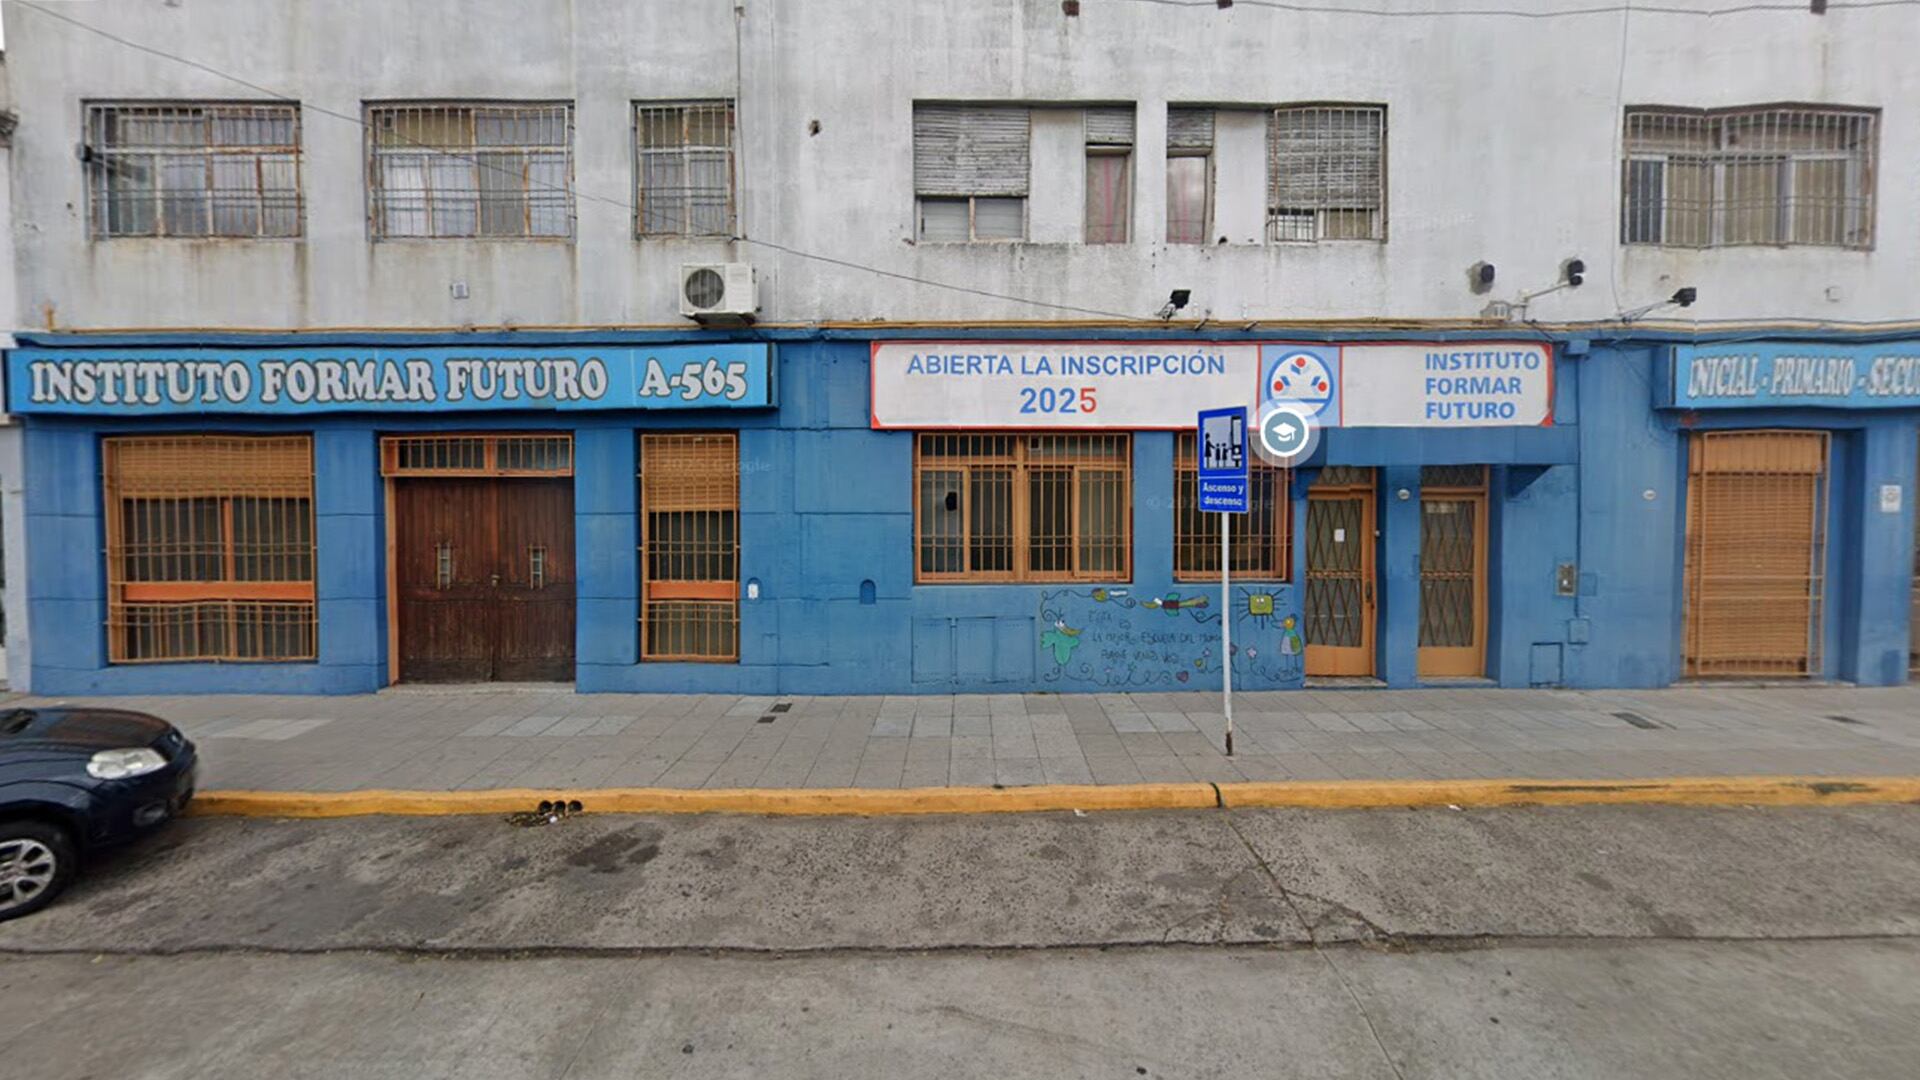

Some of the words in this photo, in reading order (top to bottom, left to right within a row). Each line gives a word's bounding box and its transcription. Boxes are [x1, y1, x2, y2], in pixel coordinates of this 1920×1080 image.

[906, 354, 1014, 375] ABIERTA
[1020, 355, 1053, 375] LA
[1060, 350, 1226, 376] INSCRIPCIÓN
[1425, 352, 1540, 370] INSTITUTO
[28, 359, 251, 404] INSTITUTO
[259, 358, 437, 402] FORMAR
[445, 357, 609, 402] FUTURO
[638, 357, 748, 401] A-565
[1425, 377, 1522, 395] FORMAR
[1687, 356, 1760, 398] INICIAL
[1770, 356, 1854, 397] PRIMARIO
[1019, 387, 1098, 414] 2025
[1425, 402, 1516, 420] FUTURO
[1203, 482, 1237, 493] Ascenso
[1238, 484, 1244, 495] y
[1204, 496, 1242, 506] descenso
